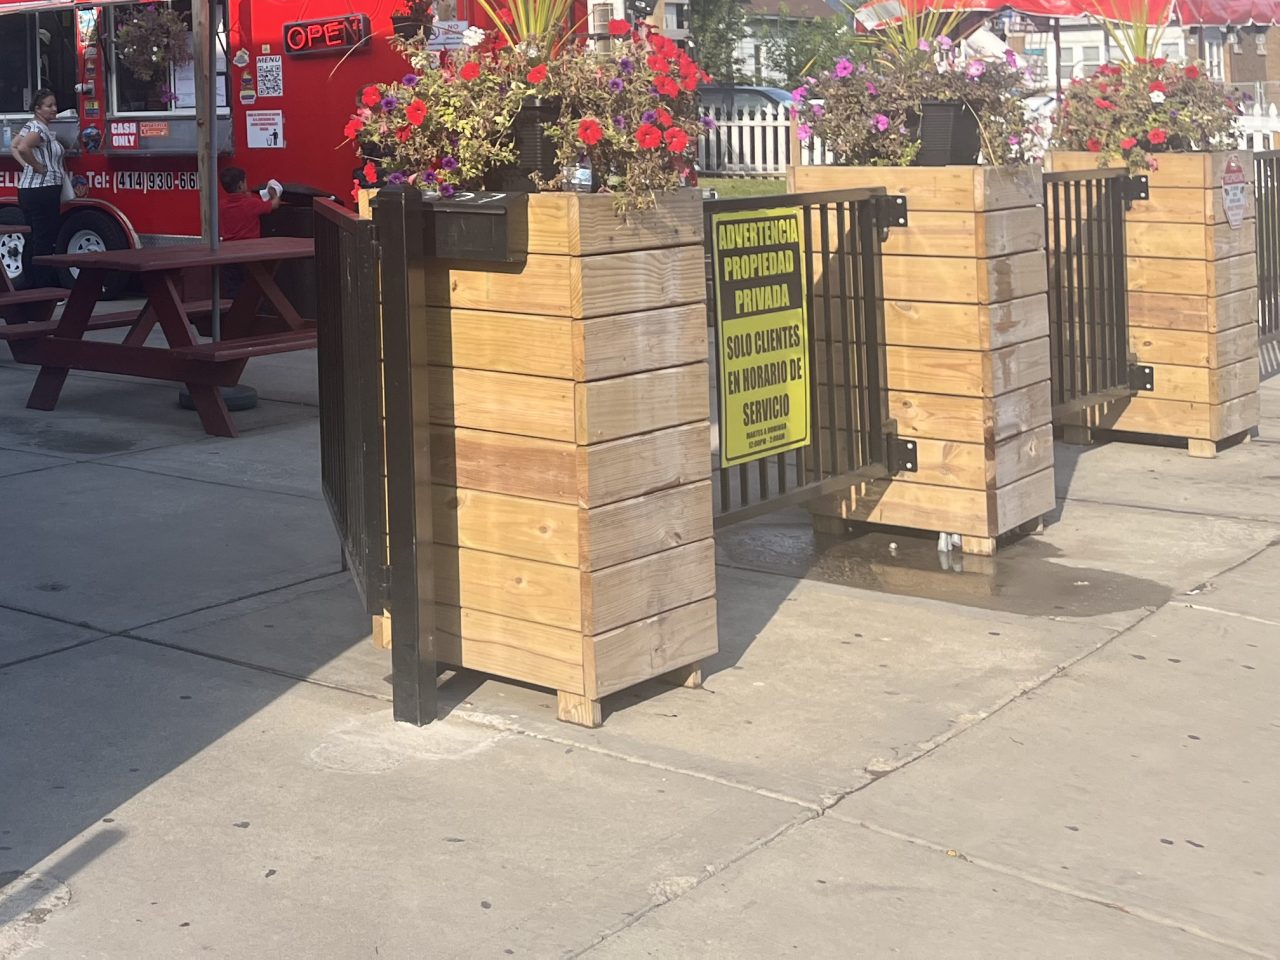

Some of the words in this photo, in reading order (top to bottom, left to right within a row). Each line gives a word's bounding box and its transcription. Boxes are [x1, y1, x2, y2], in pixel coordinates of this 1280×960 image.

[287, 17, 362, 49] OPEN
[111, 122, 136, 134] CASH
[113, 135, 135, 146] ONLY
[86, 171, 109, 188] Tel:
[113, 171, 199, 194] (414)930-66
[719, 218, 799, 250] ADVERTENCIA
[724, 250, 794, 282] PROPIEDAD
[735, 283, 790, 315] PRIVADA
[726, 333, 752, 360] SOLO
[754, 324, 800, 355] CLIENTES
[728, 369, 741, 395] EN
[742, 360, 788, 392] HORARIO
[789, 357, 802, 381] DE
[743, 393, 790, 426] SERVICIO
